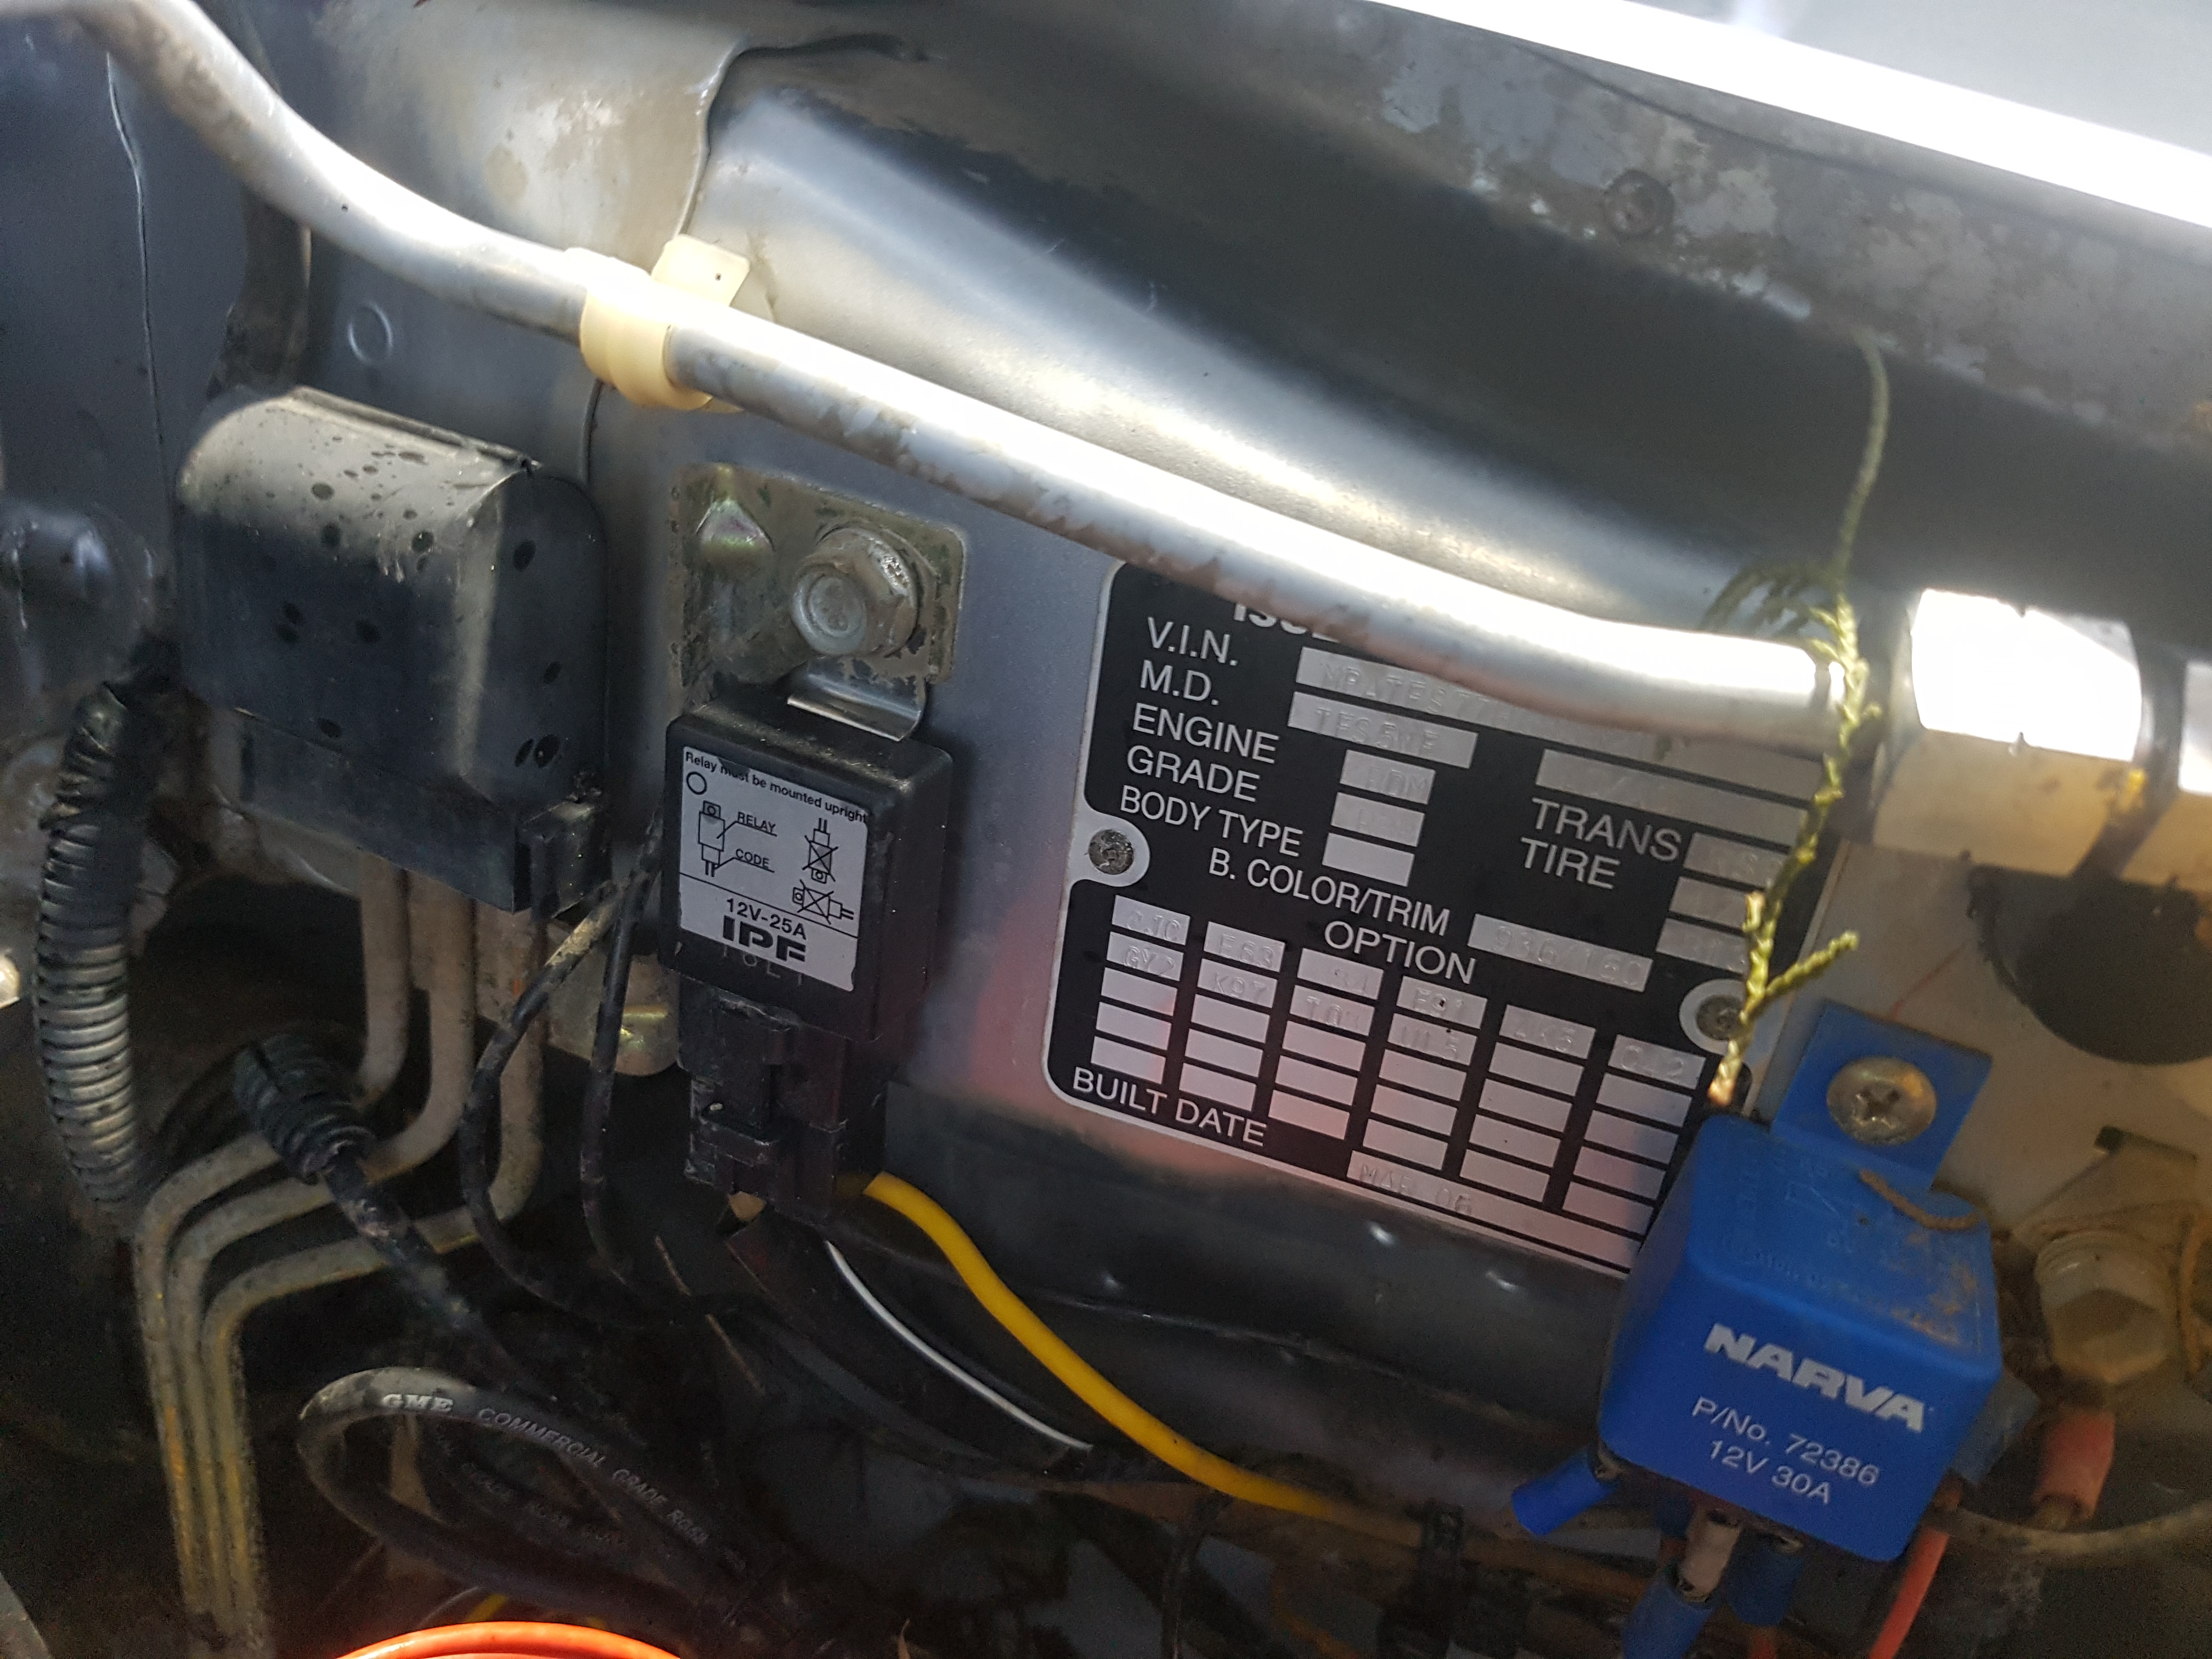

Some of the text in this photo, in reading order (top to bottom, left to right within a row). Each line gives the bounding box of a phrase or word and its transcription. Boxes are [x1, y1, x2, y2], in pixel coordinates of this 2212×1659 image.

[1147, 617, 1238, 666] V.I.N.
[1139, 659, 1219, 706] M.D.
[1132, 702, 1279, 764] ENGINE
[686, 752, 867, 823] Relay must be mounted upright
[1127, 745, 1260, 803] GRADE
[737, 811, 776, 832] RELAY
[1120, 785, 1211, 831] BODY
[1218, 809, 1304, 856] TYPE
[1532, 797, 1683, 862] TRANS
[735, 848, 770, 868] CODE
[1520, 837, 1620, 889] TIRE
[726, 898, 808, 940] 12V-25A
[1208, 848, 1450, 936] B. COLOR/TRIM
[723, 915, 806, 962] IPF
[1324, 921, 1476, 984] OPTION
[1073, 1066, 1268, 1147] BUILT DATE
[1703, 1322, 1925, 1434] NARVA
[382, 1393, 454, 1413] GME
[477, 1408, 607, 1469] COMMERCIAL
[1691, 1396, 1881, 1486] P/No. 72386
[1709, 1440, 1831, 1505] 12V 30A
